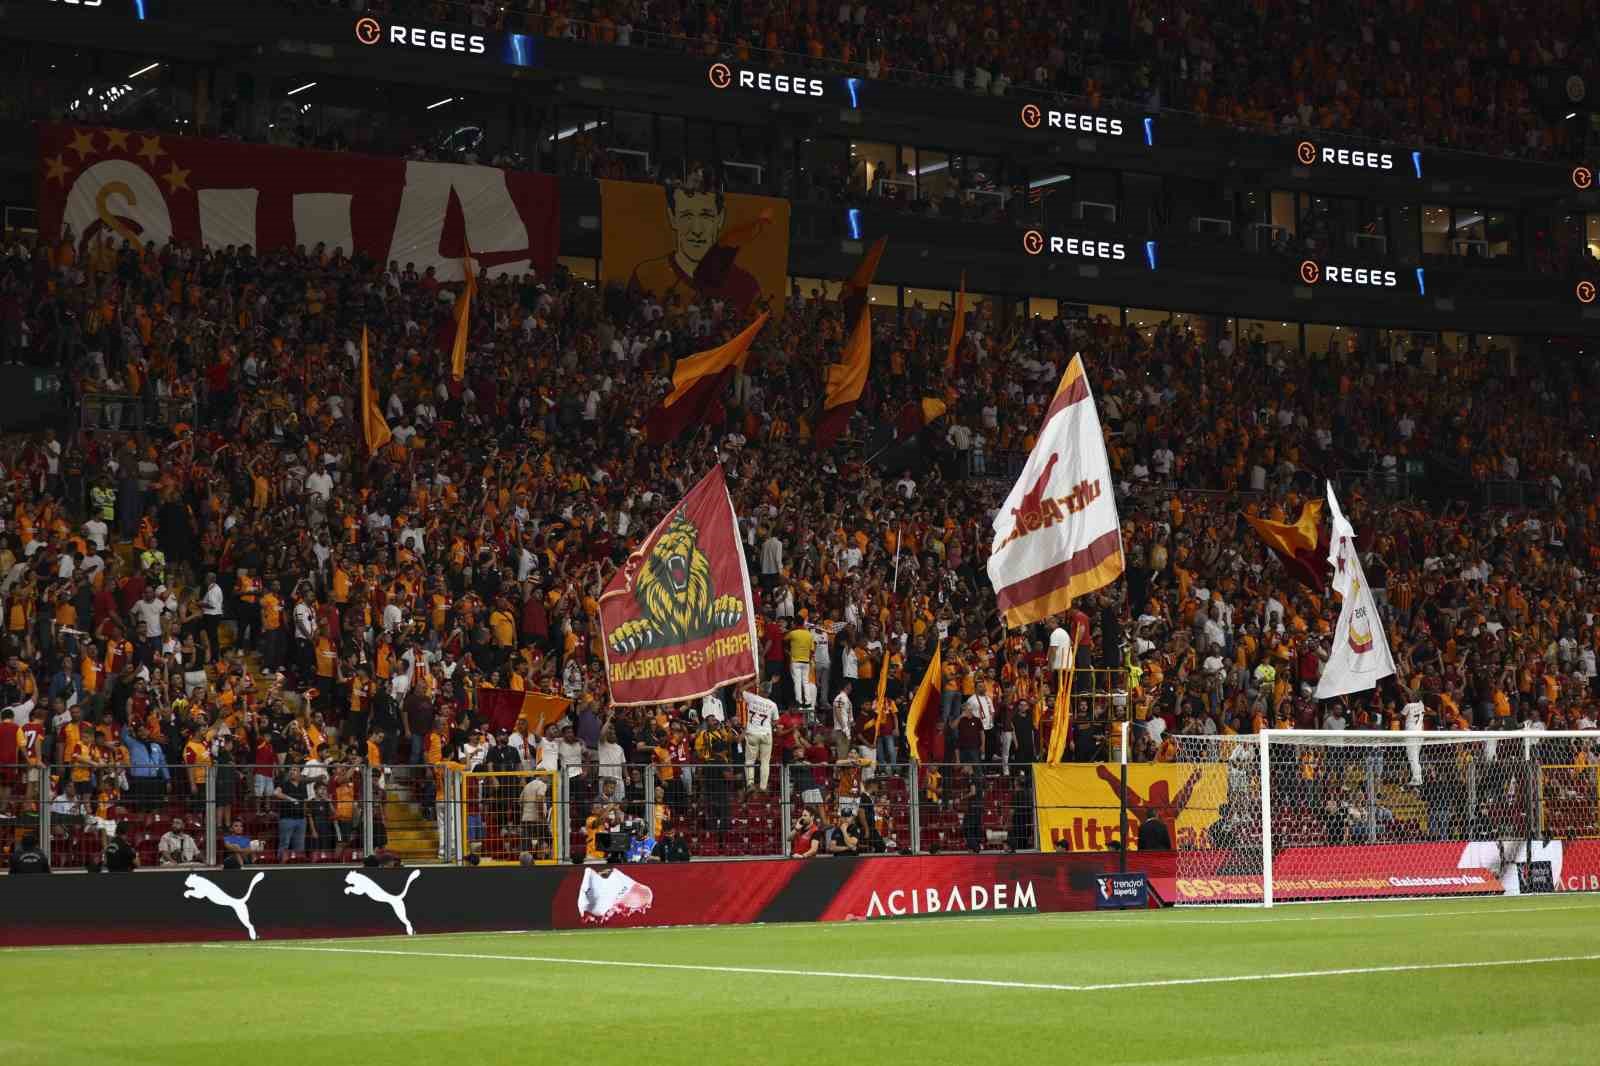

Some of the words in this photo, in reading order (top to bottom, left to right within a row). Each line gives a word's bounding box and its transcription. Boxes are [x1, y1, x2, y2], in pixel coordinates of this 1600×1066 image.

[390, 25, 485, 54] REGES
[739, 70, 824, 97] REGES
[1048, 110, 1123, 136] REGES
[1322, 147, 1393, 170] REGES
[1050, 236, 1126, 260] REGES
[1325, 265, 1397, 287] REGES
[749, 710, 768, 726] 77
[1113, 878, 1143, 889] trendyol
[866, 880, 1038, 917] ACIBADEM
